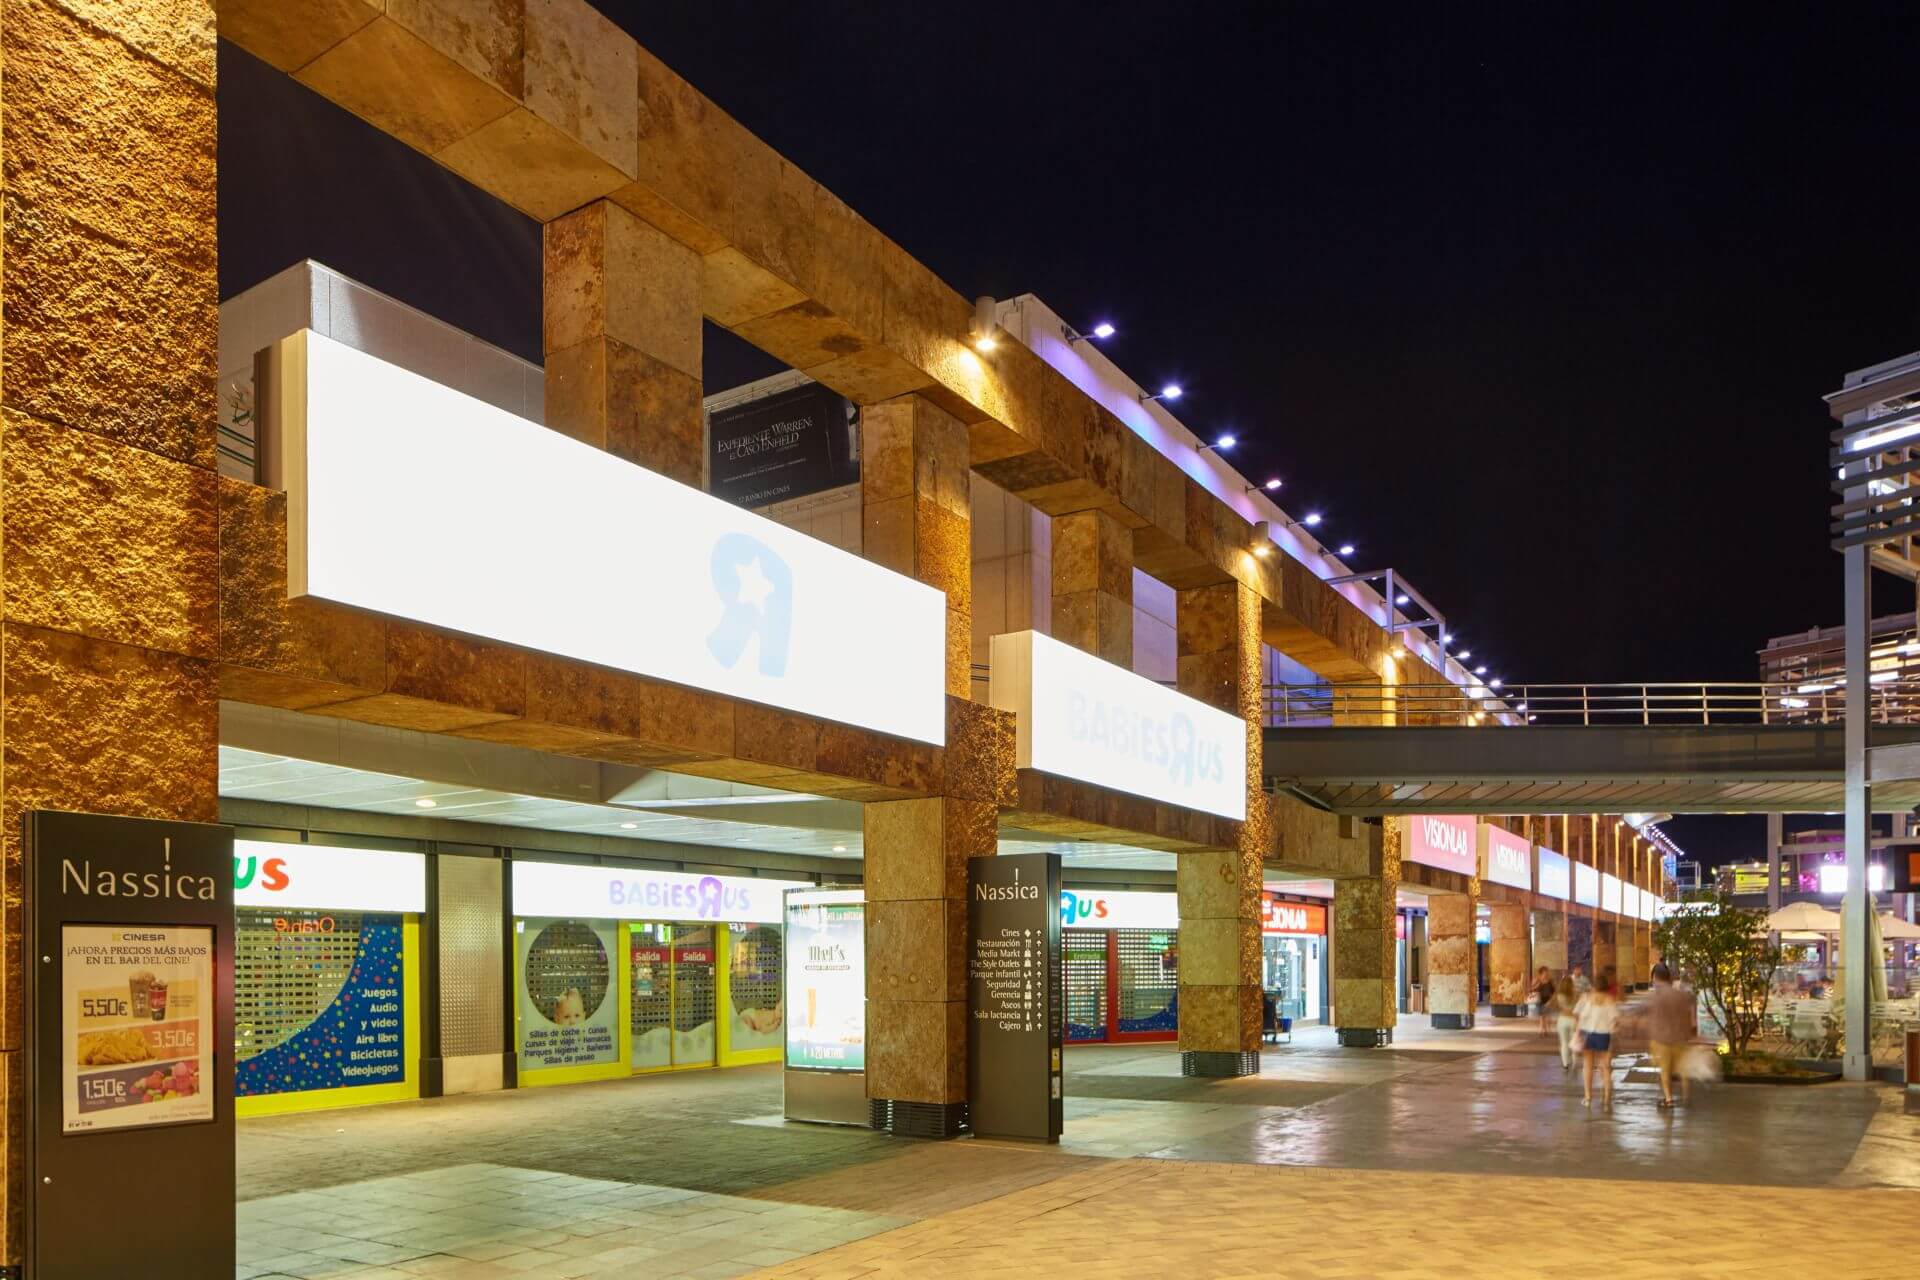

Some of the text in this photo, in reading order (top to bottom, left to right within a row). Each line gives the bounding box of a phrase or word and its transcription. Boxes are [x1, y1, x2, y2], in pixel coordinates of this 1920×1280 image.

[718, 429, 770, 453] EXPEDIENTE
[737, 444, 760, 458] CASO
[1422, 815, 1468, 857] VISIONLAB
[62, 841, 216, 900] Nassica
[976, 871, 1039, 901] Nassica
[122, 933, 166, 942] CINESA
[1001, 928, 1020, 938] Cines
[976, 938, 1021, 949] Restauración
[110, 946, 151, 955] PRECIOS
[154, 945, 176, 955] MÁS
[178, 946, 207, 956] BAJOS
[977, 949, 1021, 959] Media Markt
[86, 956, 190, 965] EN EL BAR DEL CINE!
[635, 951, 661, 962] Salida
[682, 951, 706, 962] Salida
[983, 959, 998, 970] Style
[998, 959, 1021, 969] Outlets
[986, 979, 1021, 990] Seguridad
[361, 988, 399, 1000] Juegos
[991, 990, 1021, 999] Gerencia
[370, 1002, 399, 1013] Audio
[1001, 1000, 1021, 1009] Aseos
[974, 1010, 989, 1020] Sala
[360, 1018, 399, 1031] y video
[999, 1021, 1021, 1032] Cajero
[550, 1028, 559, 1037] de
[561, 1028, 580, 1036] coche
[356, 1032, 399, 1045] Aire libre
[549, 1038, 557, 1046] de
[350, 1048, 399, 1061] Bicicletas
[564, 1055, 573, 1063] de
[575, 1053, 595, 1063] paseo
[342, 1064, 399, 1077] Videojuegos
